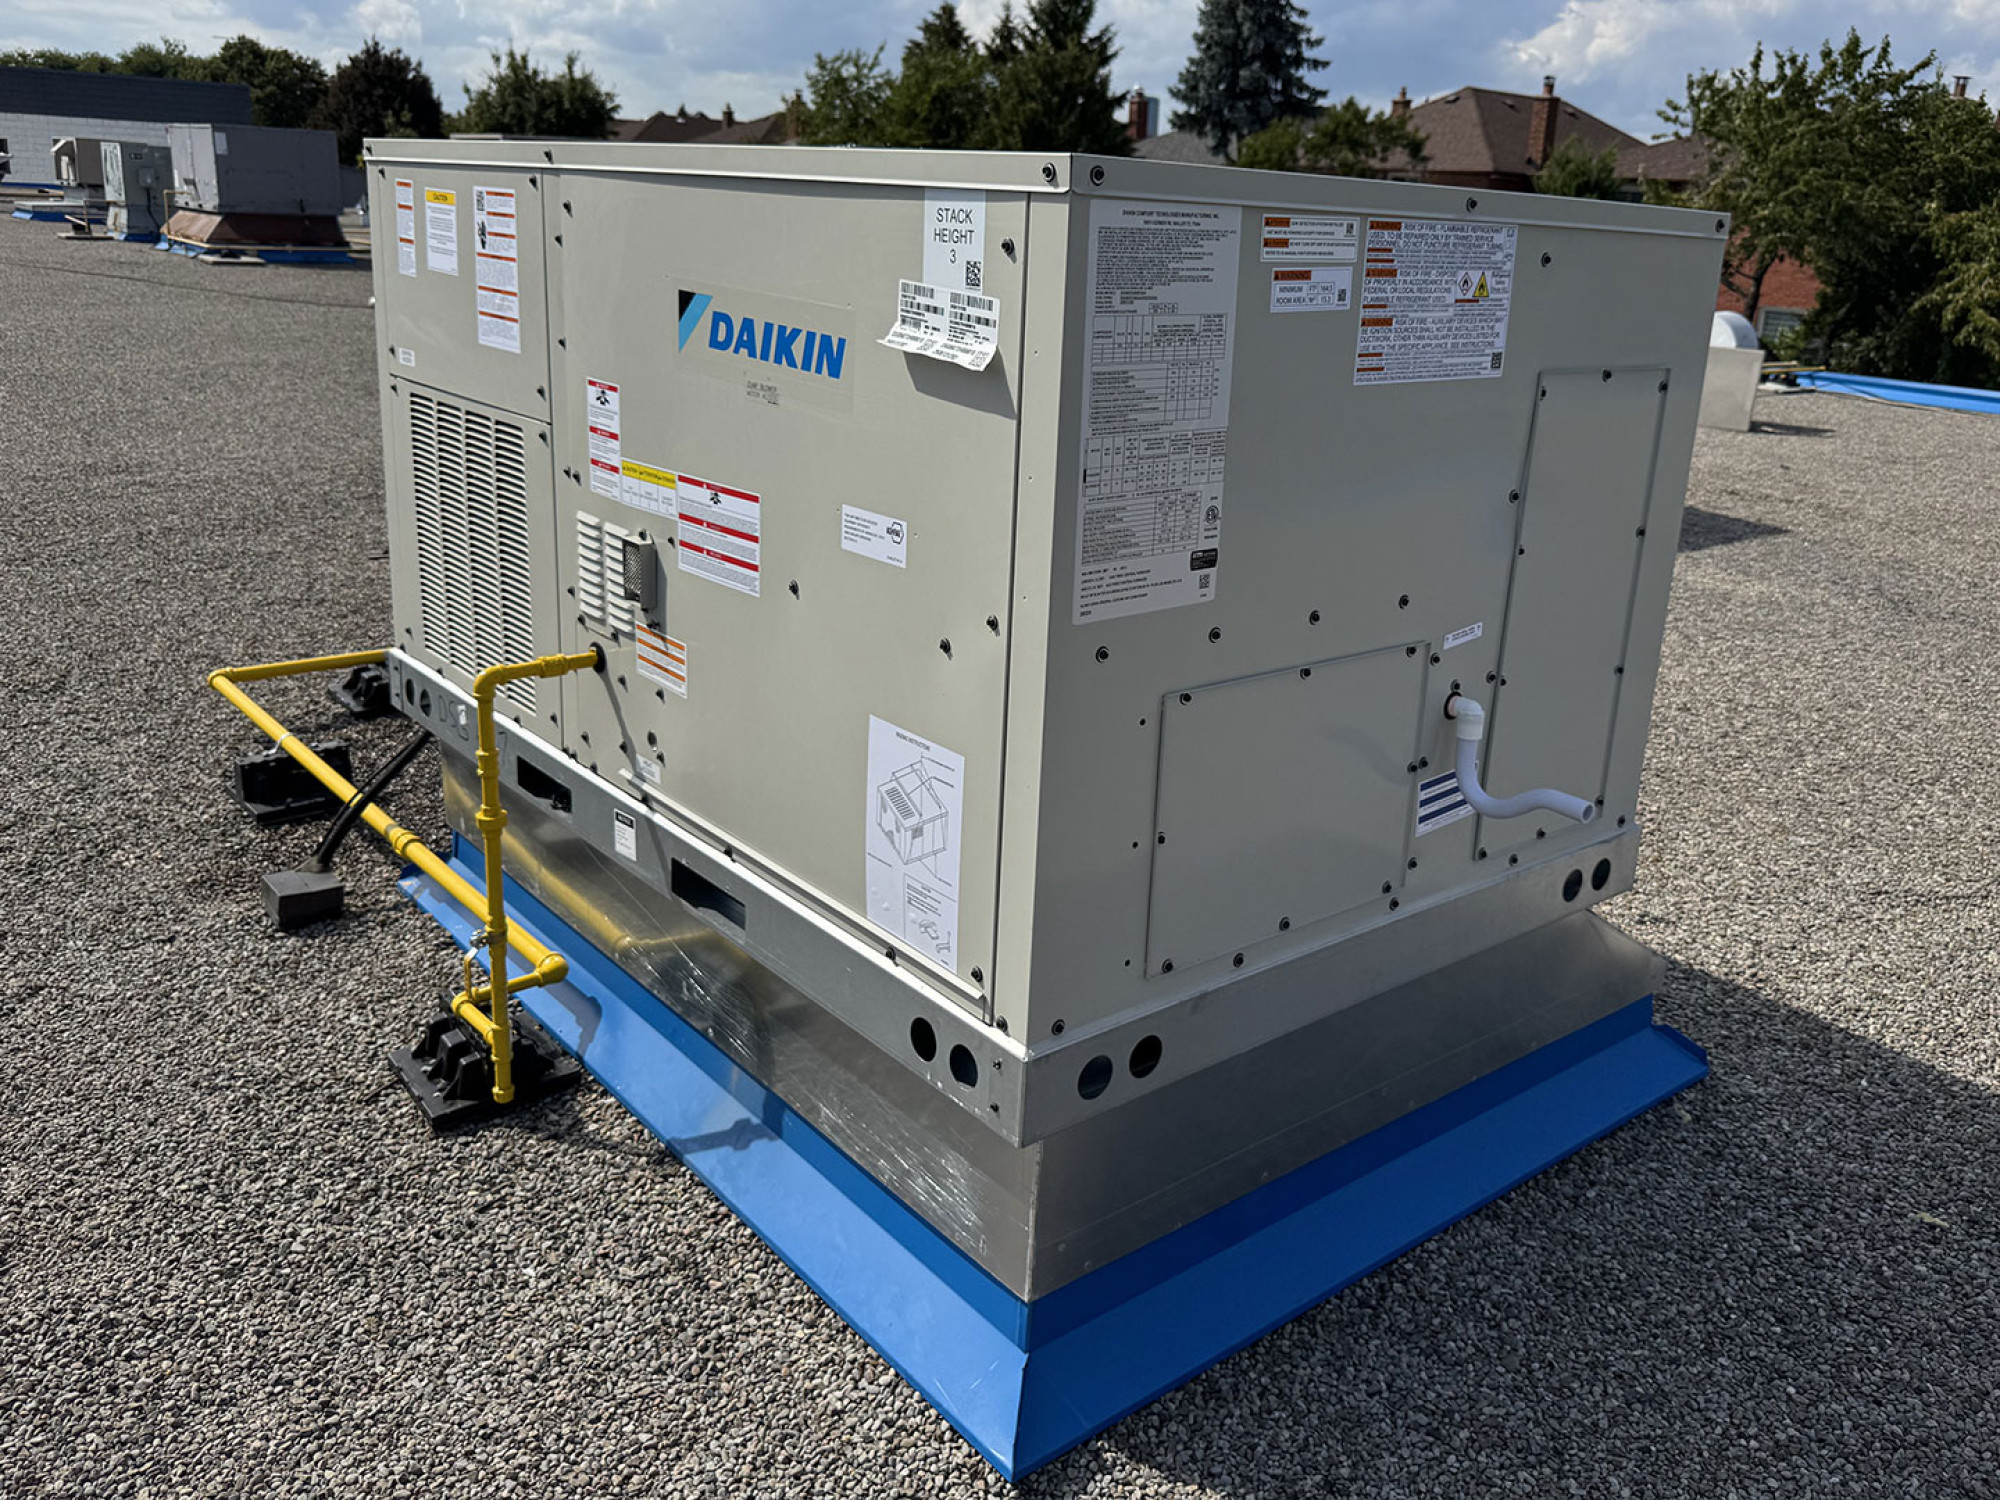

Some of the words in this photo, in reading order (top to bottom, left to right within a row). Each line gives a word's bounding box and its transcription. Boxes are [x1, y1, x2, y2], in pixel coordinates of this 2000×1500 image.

[936, 207, 973, 224] STACK
[934, 228, 975, 244] HEIGHT
[949, 248, 956, 264] 3
[708, 310, 847, 380] DAIKIN
